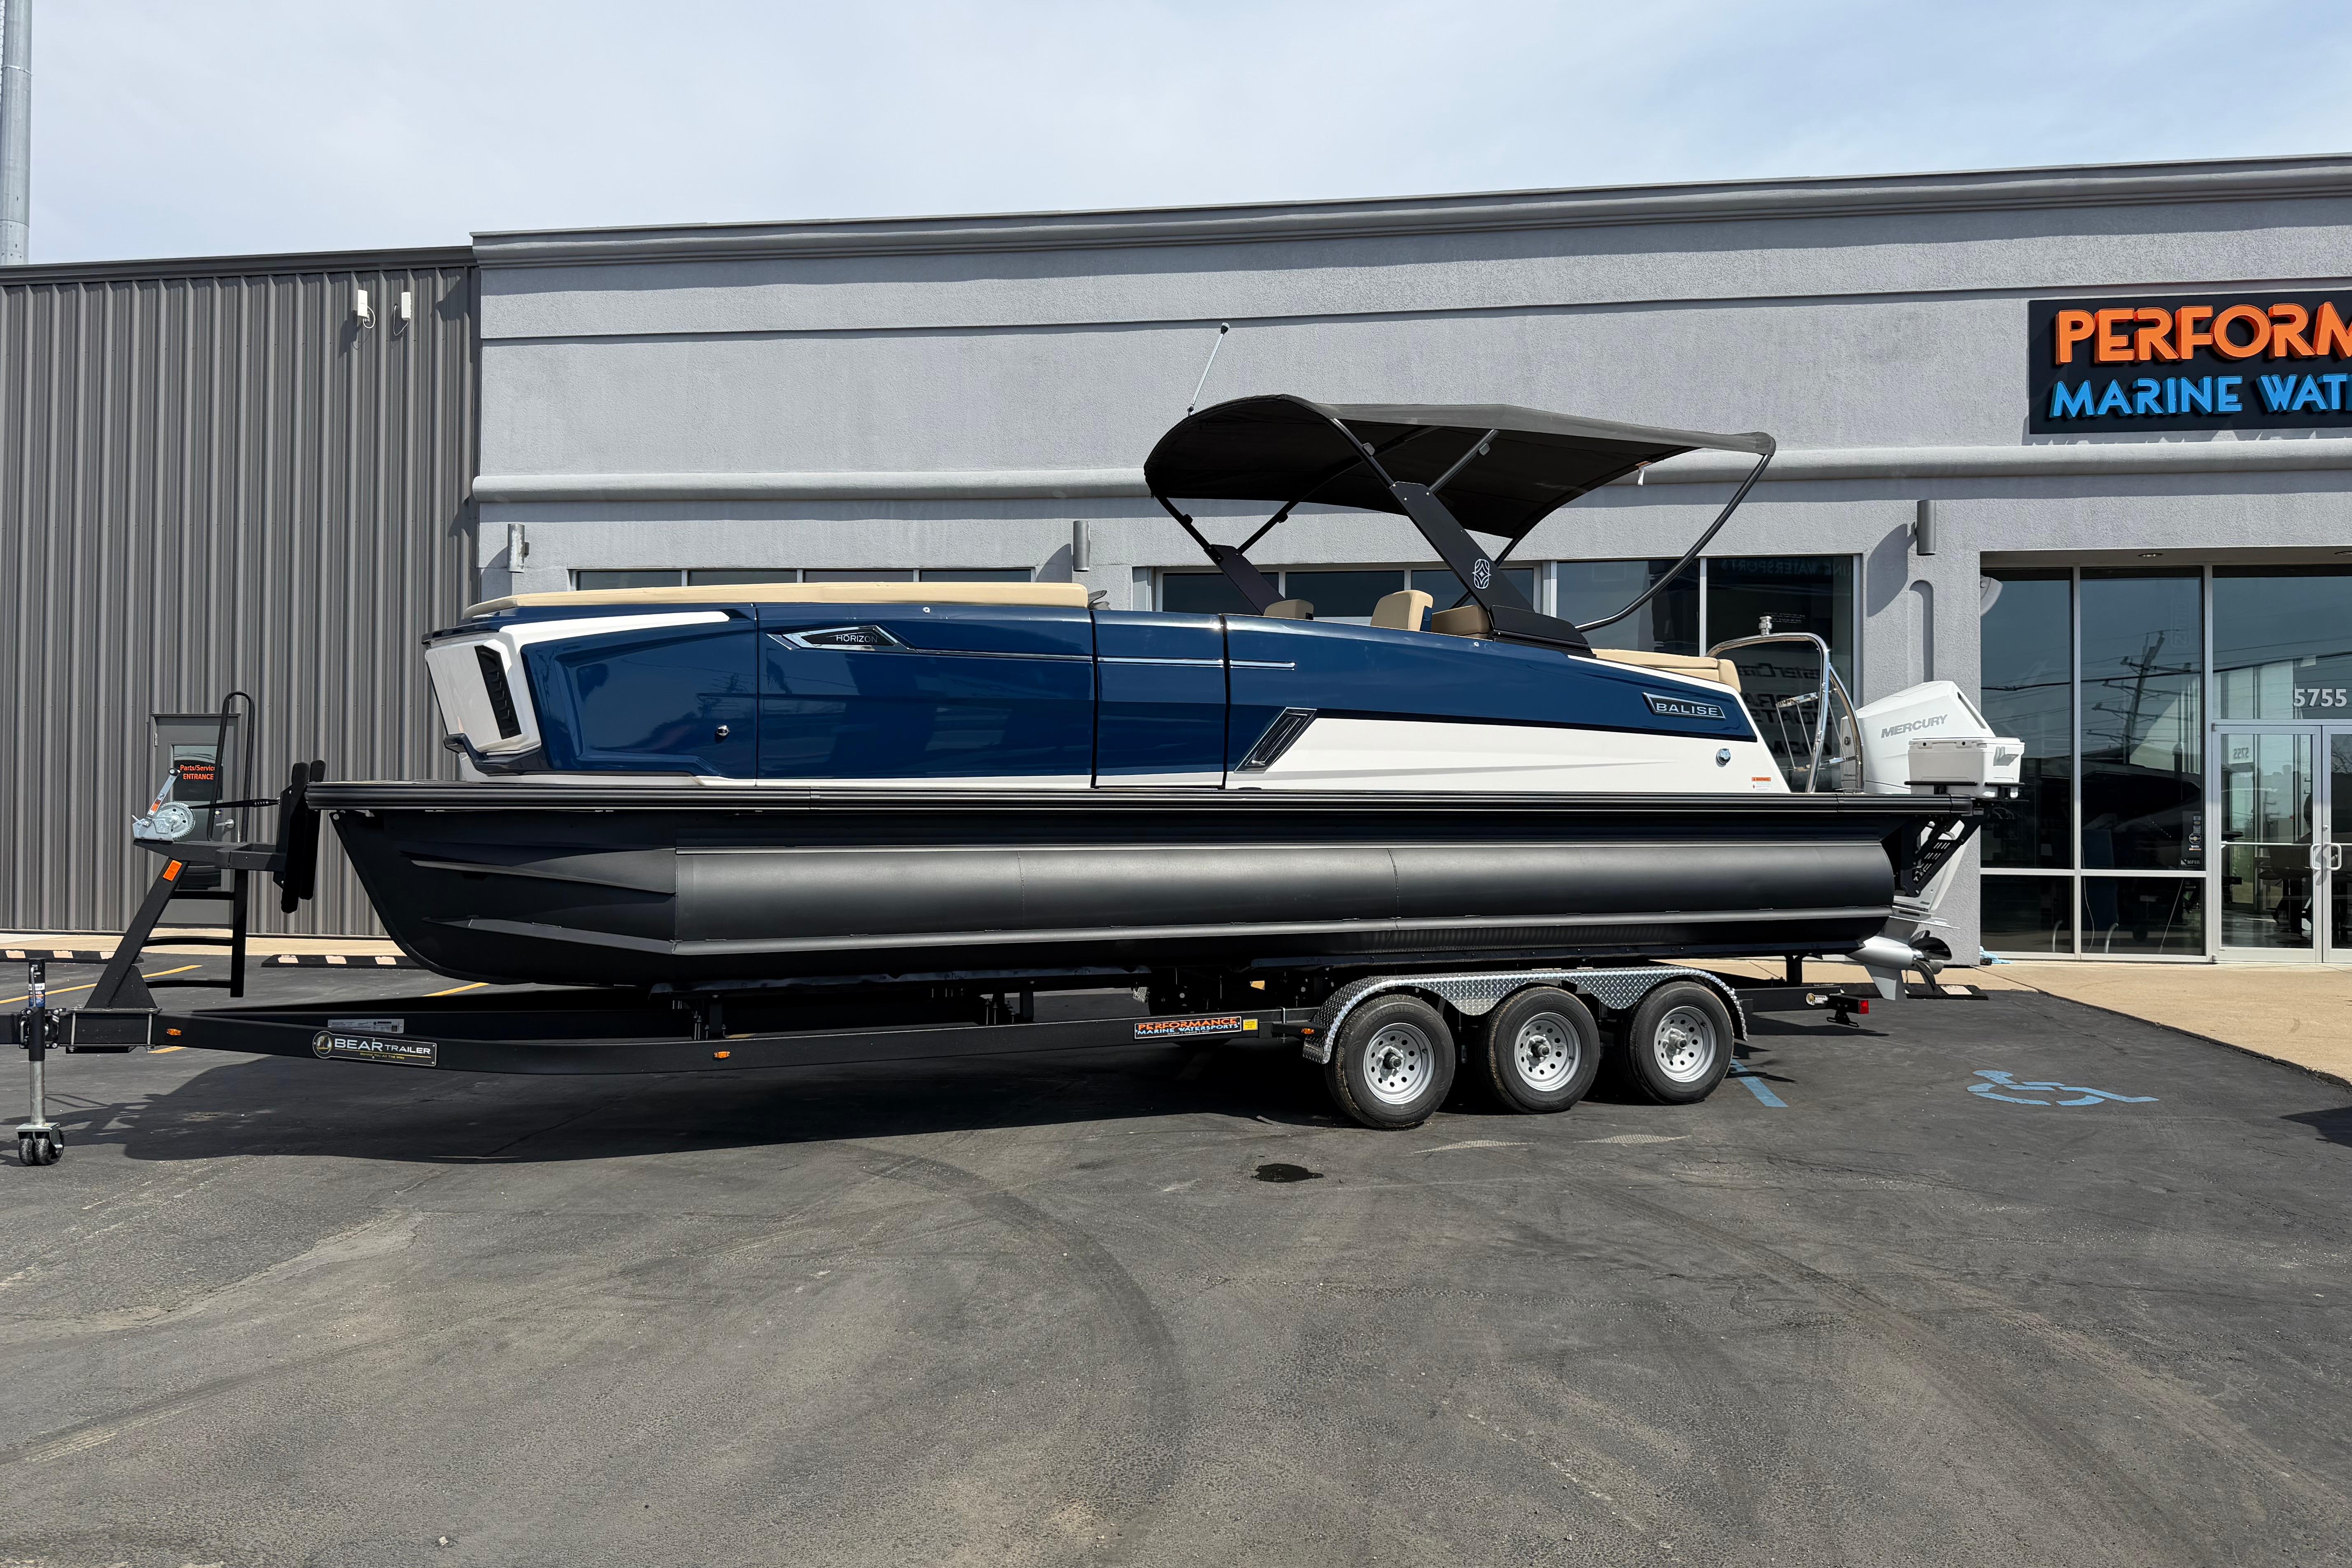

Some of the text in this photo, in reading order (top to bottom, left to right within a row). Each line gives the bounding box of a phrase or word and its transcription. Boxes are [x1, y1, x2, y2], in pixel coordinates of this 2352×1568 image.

[2049, 373, 2352, 419] MARINE WAT
[2294, 688, 2347, 707] 5755
[1656, 702, 1718, 716] BALISE
[1881, 714, 1948, 738] MERCURY
[1138, 1018, 1238, 1030] PERFORMANCE
[334, 1038, 431, 1055] BEAR TRAILER
